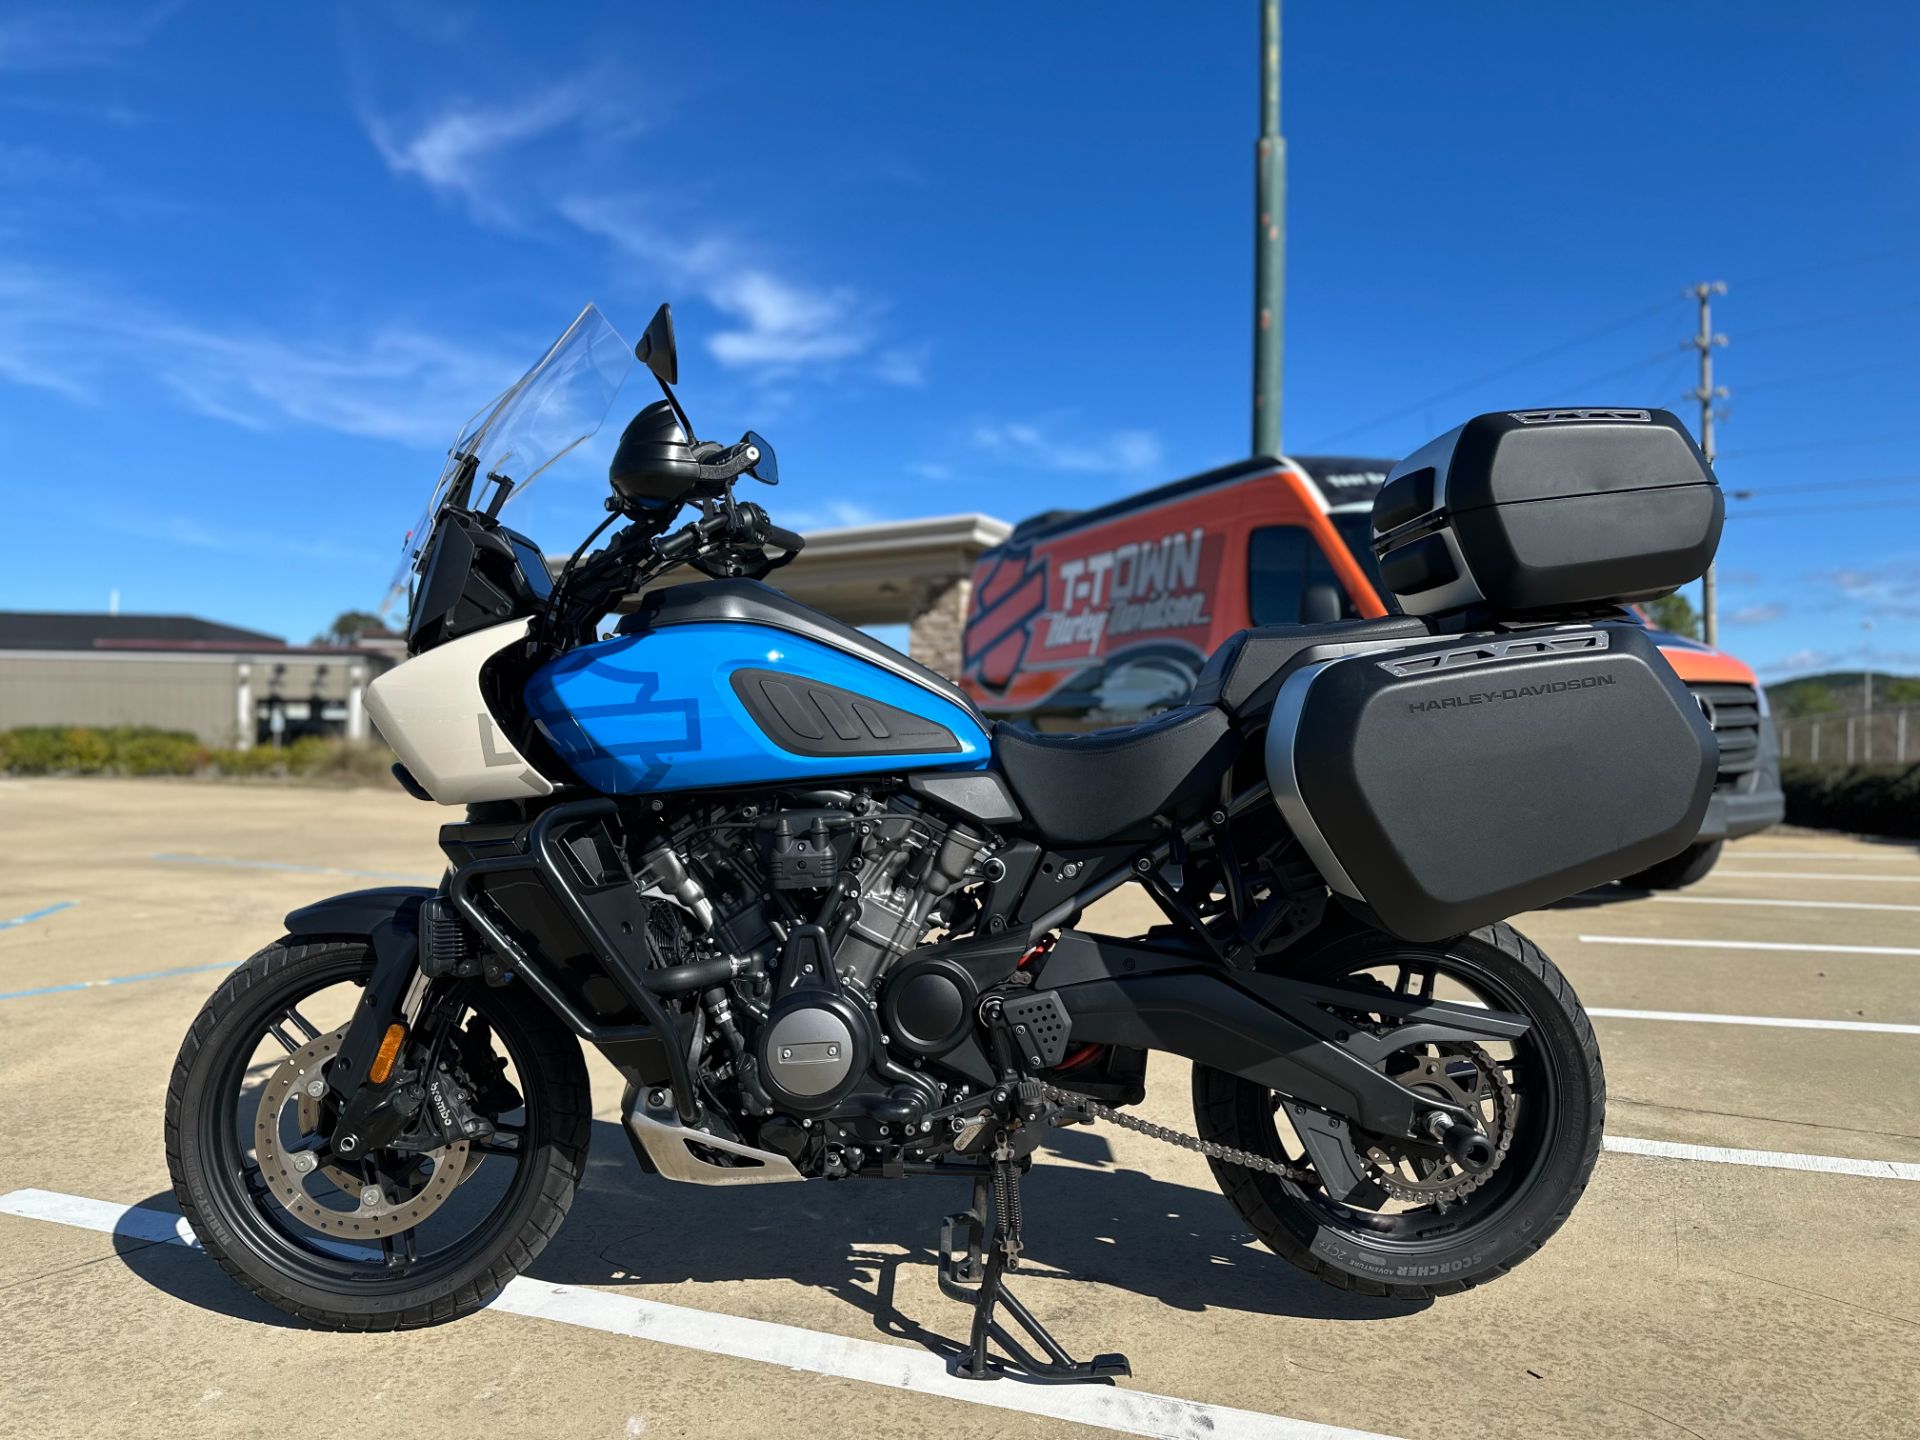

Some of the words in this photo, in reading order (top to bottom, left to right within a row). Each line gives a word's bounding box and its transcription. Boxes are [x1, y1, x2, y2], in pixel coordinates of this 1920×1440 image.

[1060, 528, 1204, 612] T-TOWN
[430, 1081, 452, 1126] brembo
[1396, 1253, 1482, 1278] SCORCHER
